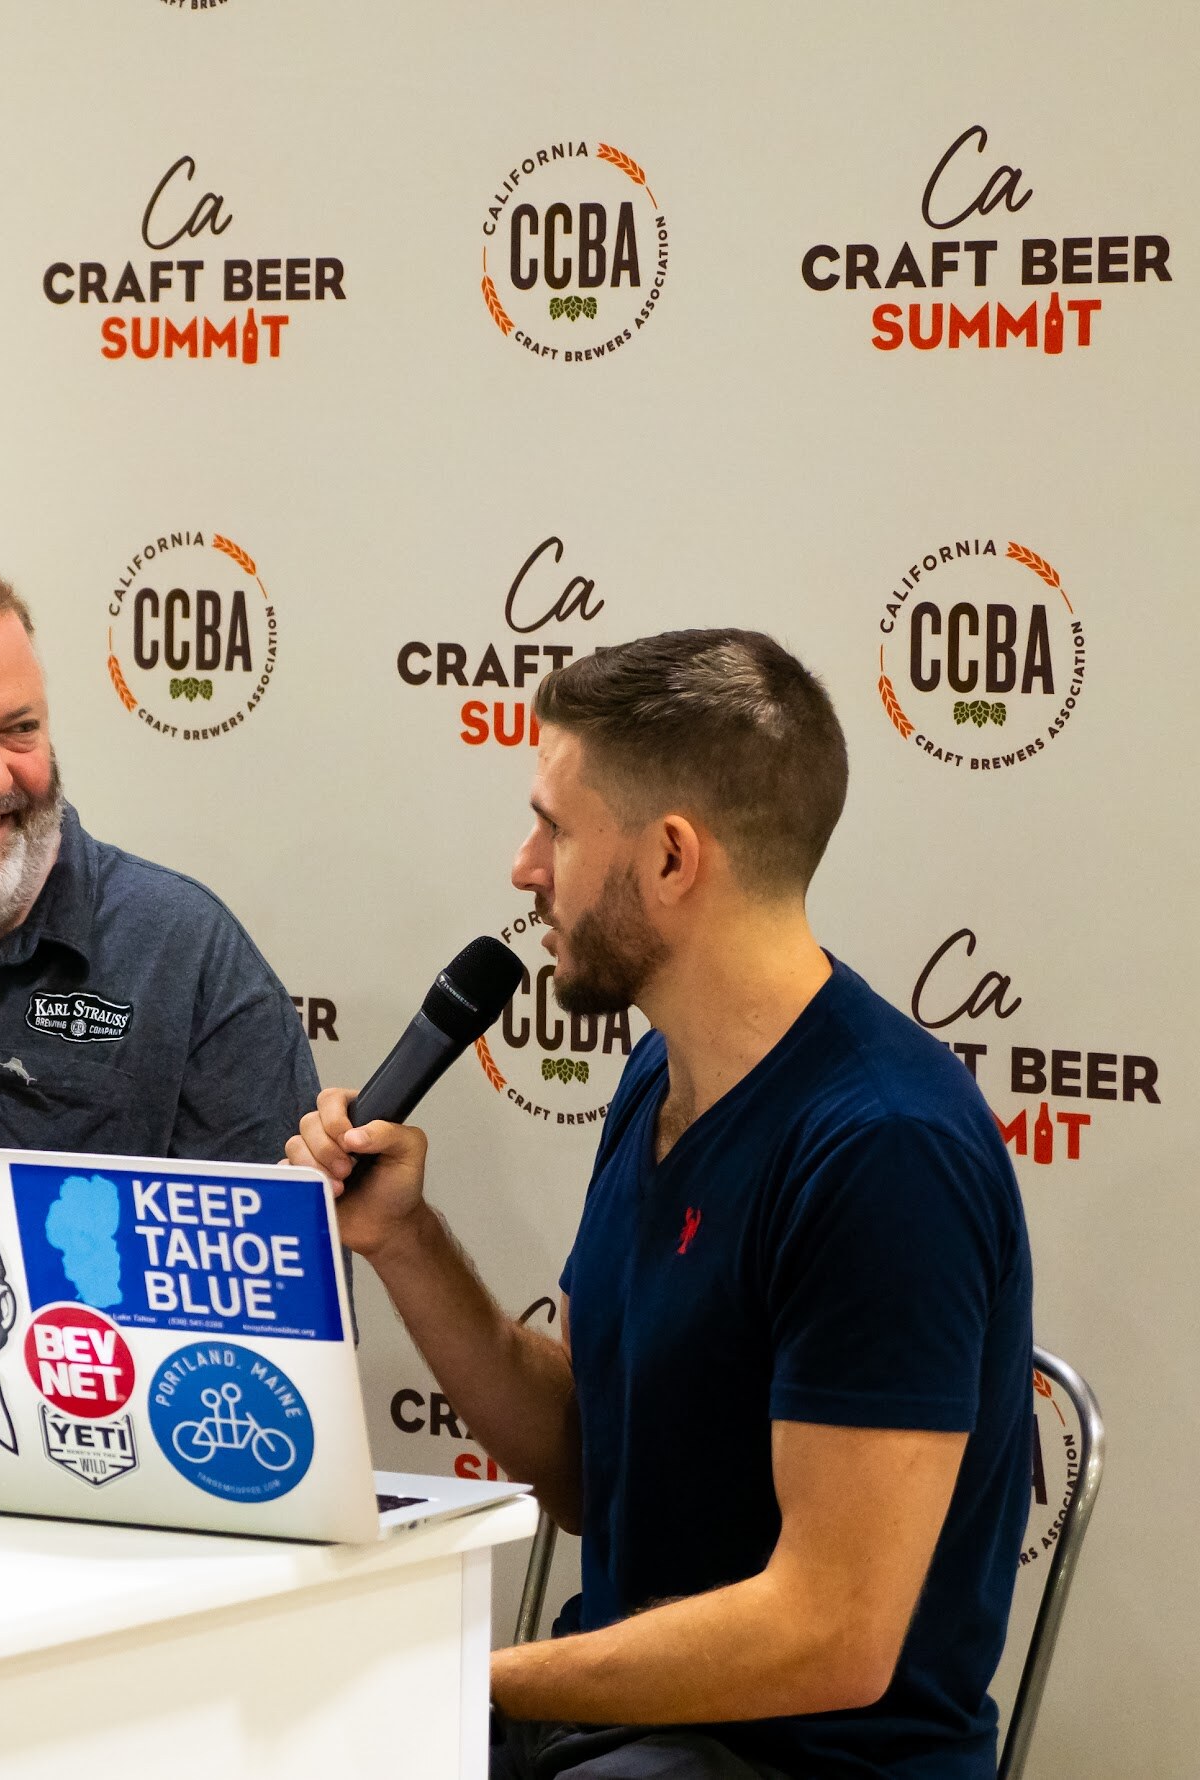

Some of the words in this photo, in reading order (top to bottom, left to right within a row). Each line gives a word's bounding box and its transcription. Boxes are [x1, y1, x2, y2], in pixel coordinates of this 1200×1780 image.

[141, 155, 233, 250] Ca
[483, 141, 588, 236] CALIFORNIA
[921, 125, 1033, 230] Ca
[510, 201, 641, 290] CCBA
[801, 240, 998, 291] CRAFT
[1021, 234, 1173, 286] BEER
[43, 259, 204, 304] CRAFT
[223, 257, 347, 301] BEER
[515, 330, 559, 360] CRAFT
[564, 328, 632, 362] BREWERS
[634, 215, 668, 330] ASSOCIATION
[101, 307, 289, 365] SUMMIT
[871, 291, 1102, 355] SUMMIT
[109, 531, 204, 616] CALIFORNIA
[504, 536, 605, 634] Ca
[880, 539, 997, 634] CALIFORNIA
[133, 587, 253, 672] CCBA
[910, 601, 1055, 695] CCBA
[138, 708, 178, 738] CRAFT
[183, 711, 245, 741] BREWERS
[247, 605, 277, 712] ASSOCIATION
[397, 641, 573, 688] CRAFT
[915, 734, 963, 767] CRAFT
[970, 738, 1045, 770] BREWERS
[1047, 621, 1086, 739] ASSOCIATION
[911, 928, 1022, 1029] Ca
[34, 999, 70, 1017] KARL
[73, 1000, 128, 1028] STRAUSS
[35, 1016, 67, 1029] BREWING
[89, 1025, 123, 1036] COMPANY
[1011, 1046, 1161, 1104] BEER
[507, 1088, 550, 1121] CRAFT
[132, 1180, 262, 1228] KEEP
[135, 1225, 304, 1278] TAHOE
[144, 1270, 277, 1320] BLUE
[33, 1323, 116, 1365] BEV
[38, 1360, 123, 1401] NET
[251, 1362, 302, 1419] MAINE
[49, 1421, 128, 1451] YETI
[79, 1457, 107, 1475] WILD
